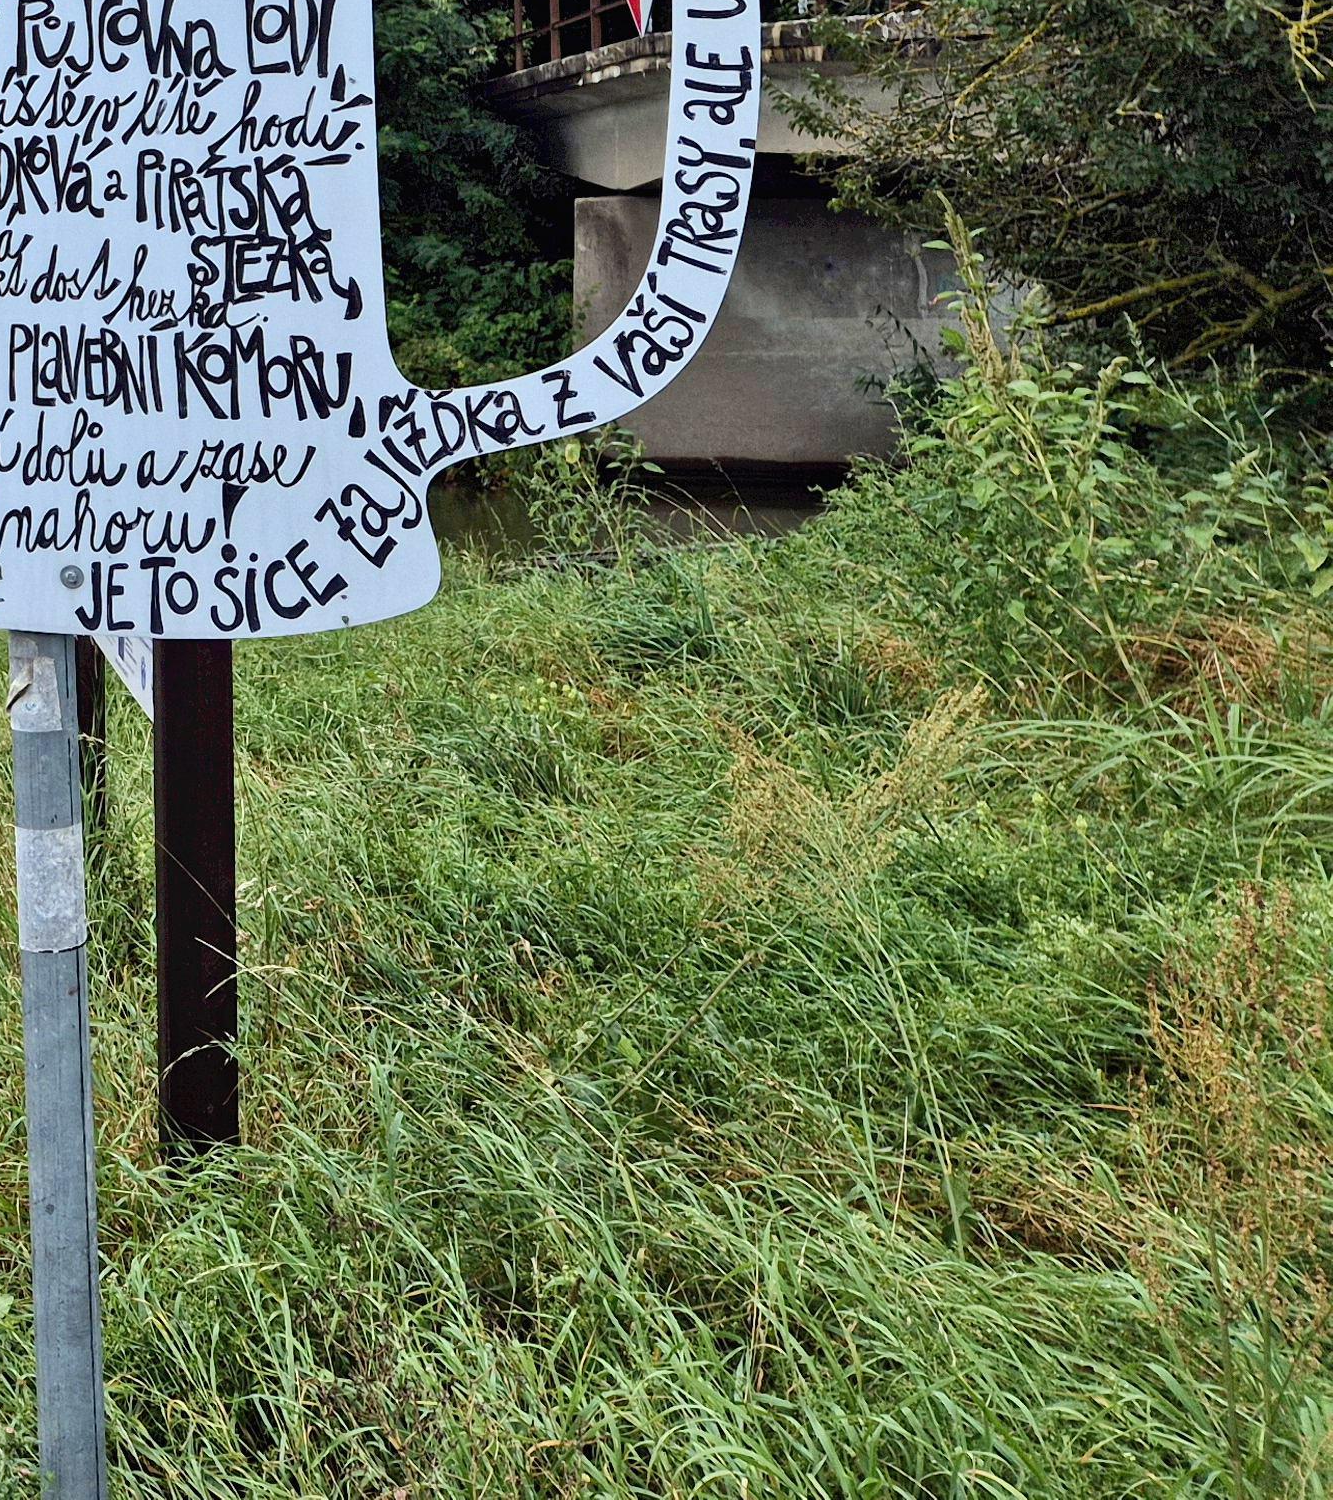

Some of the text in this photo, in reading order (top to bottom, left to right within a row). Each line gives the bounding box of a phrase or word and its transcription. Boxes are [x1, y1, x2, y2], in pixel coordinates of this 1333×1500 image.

[83, 90, 137, 145] v
[122, 72, 224, 145] létě
[208, 79, 373, 154] hodí.
[103, 169, 128, 207] a
[31, 238, 122, 303] dost
[174, 324, 366, 438] KOMORU,
[23, 407, 127, 486] dolů
[137, 449, 189, 488] a
[180, 439, 316, 493] zase
[74, 561, 136, 632] JE
[139, 556, 200, 634] TO
